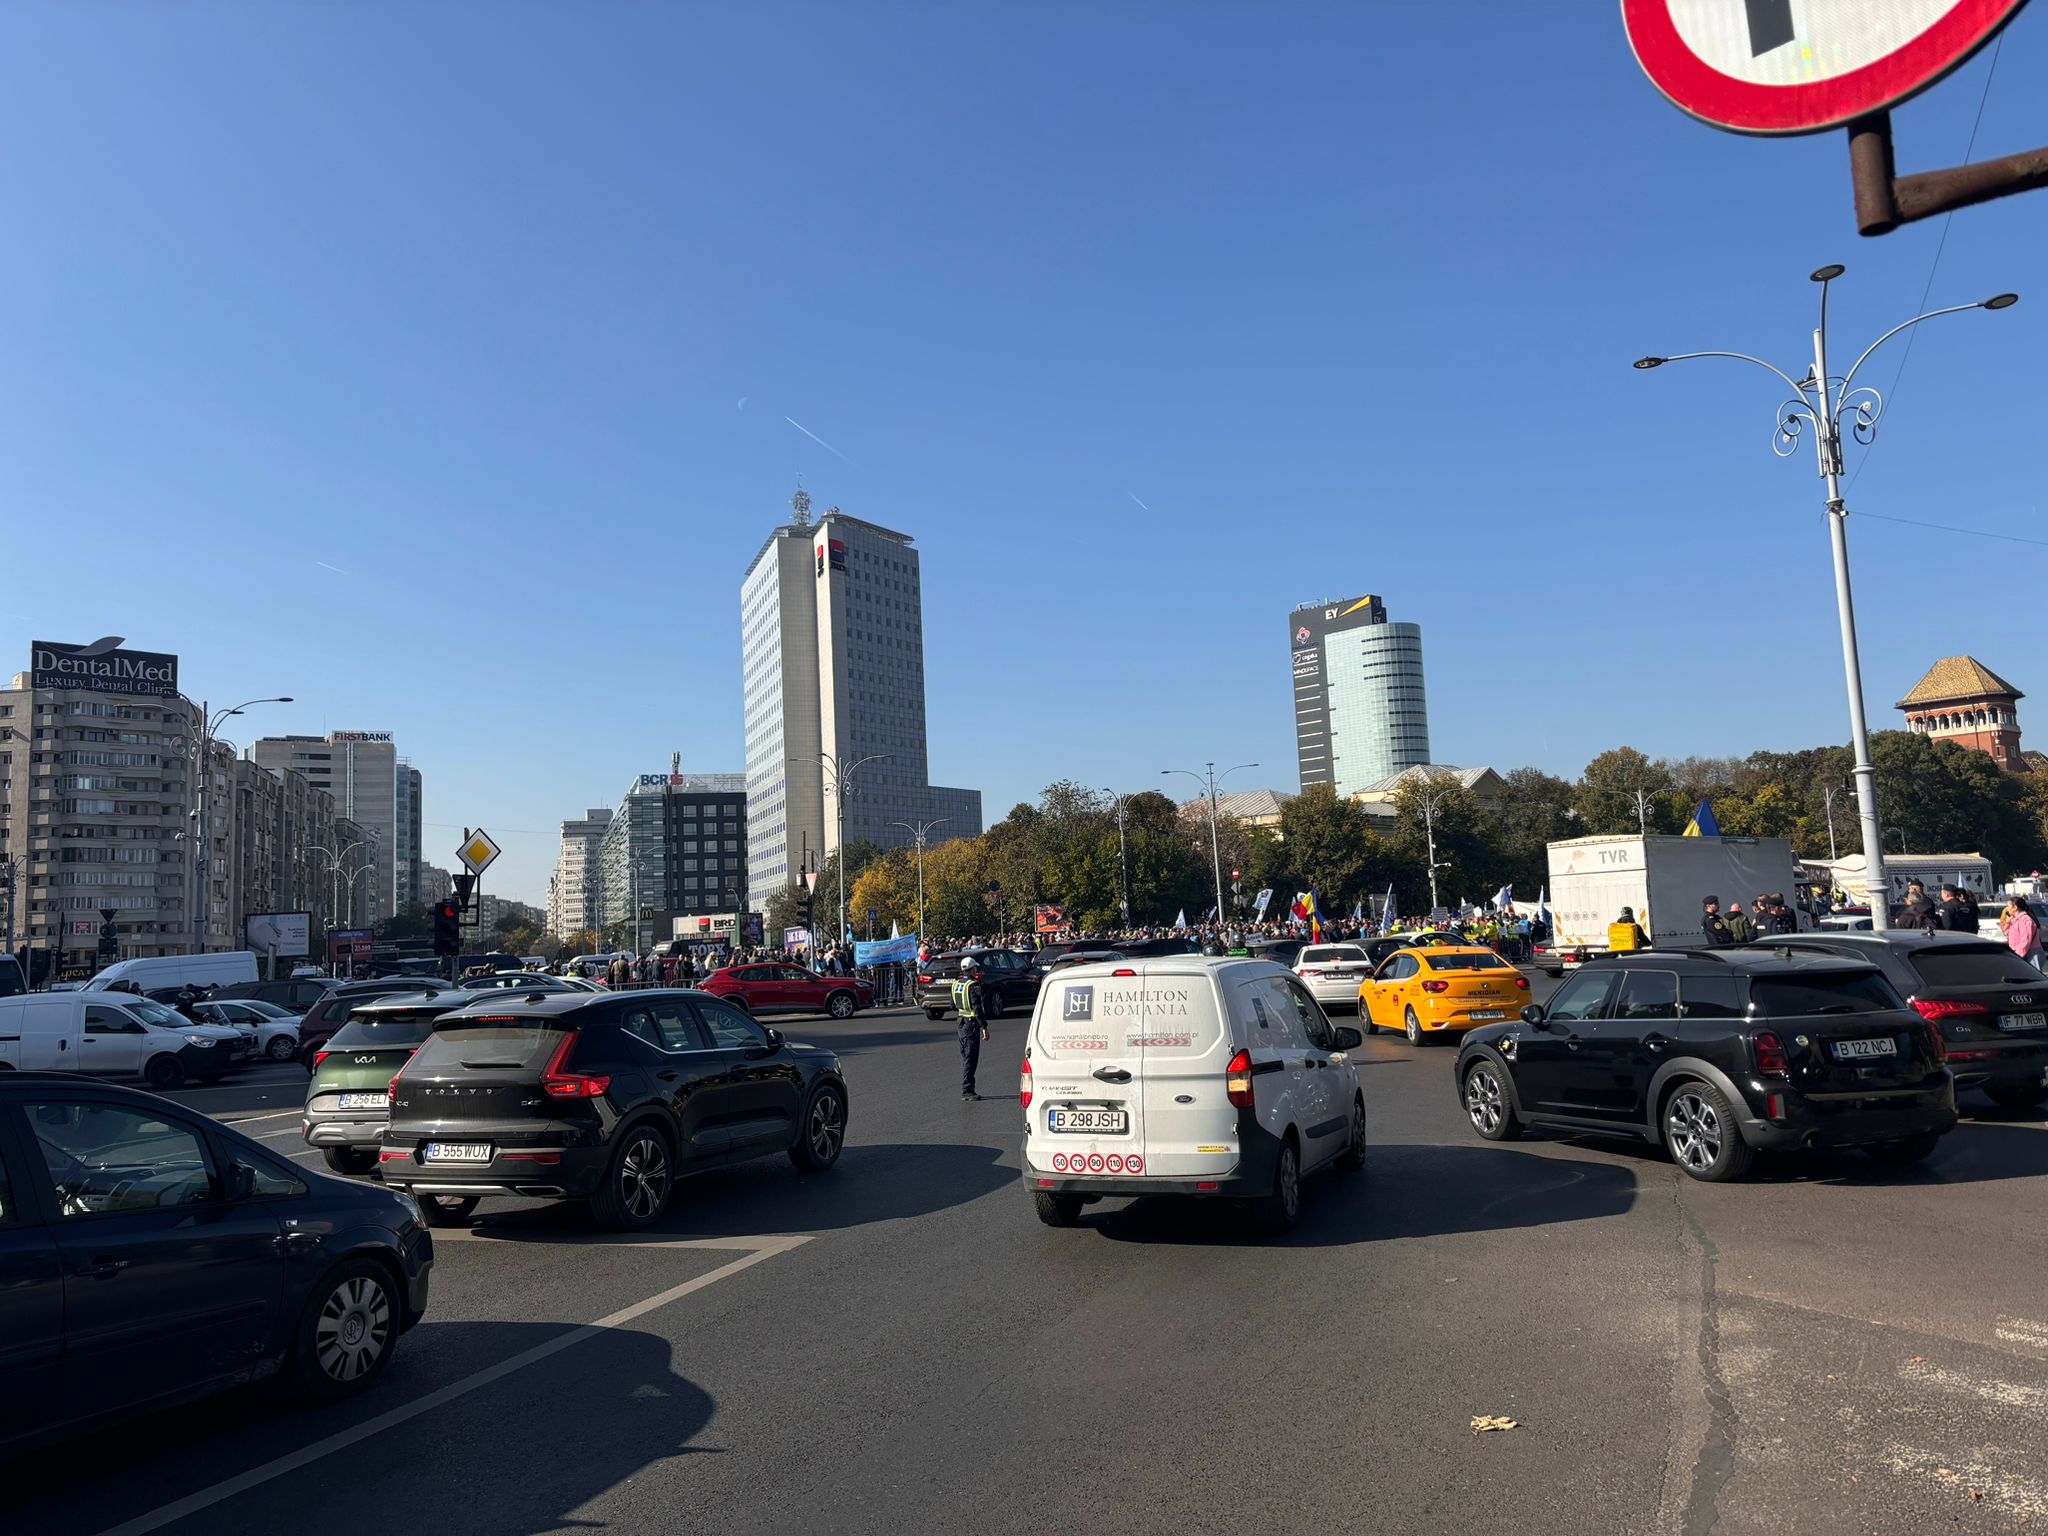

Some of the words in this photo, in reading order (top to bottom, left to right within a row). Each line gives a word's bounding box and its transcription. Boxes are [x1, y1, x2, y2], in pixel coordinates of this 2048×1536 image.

[1325, 608, 1339, 620] EY
[35, 649, 174, 682] DentalMed
[36, 672, 86, 689] Luxury
[91, 677, 133, 693] Dental
[334, 732, 391, 742] FIRSTBANK
[640, 774, 669, 786] BCR
[1598, 849, 1628, 864] TVR
[714, 919, 736, 927] BRD
[1104, 990, 1189, 1003] HAMILTON
[1103, 1004, 1187, 1017] ROMANIA
[2014, 1015, 2024, 1026] 77
[2025, 1014, 2045, 1025] WBR
[1839, 1043, 1849, 1056] B
[1851, 1041, 1870, 1054] 122
[1871, 1039, 1893, 1053] NCJ
[345, 1094, 351, 1104] B
[1056, 1112, 1066, 1127] B
[1070, 1112, 1093, 1127] 298
[1094, 1112, 1120, 1128] JSH
[432, 1145, 441, 1157] B
[443, 1144, 463, 1157] 555
[464, 1145, 488, 1158] WUX
[1056, 1159, 1066, 1167] 50
[1073, 1159, 1084, 1167] 70
[1091, 1159, 1101, 1167] 90
[1109, 1159, 1121, 1167] 110
[1128, 1160, 1141, 1168] 130
